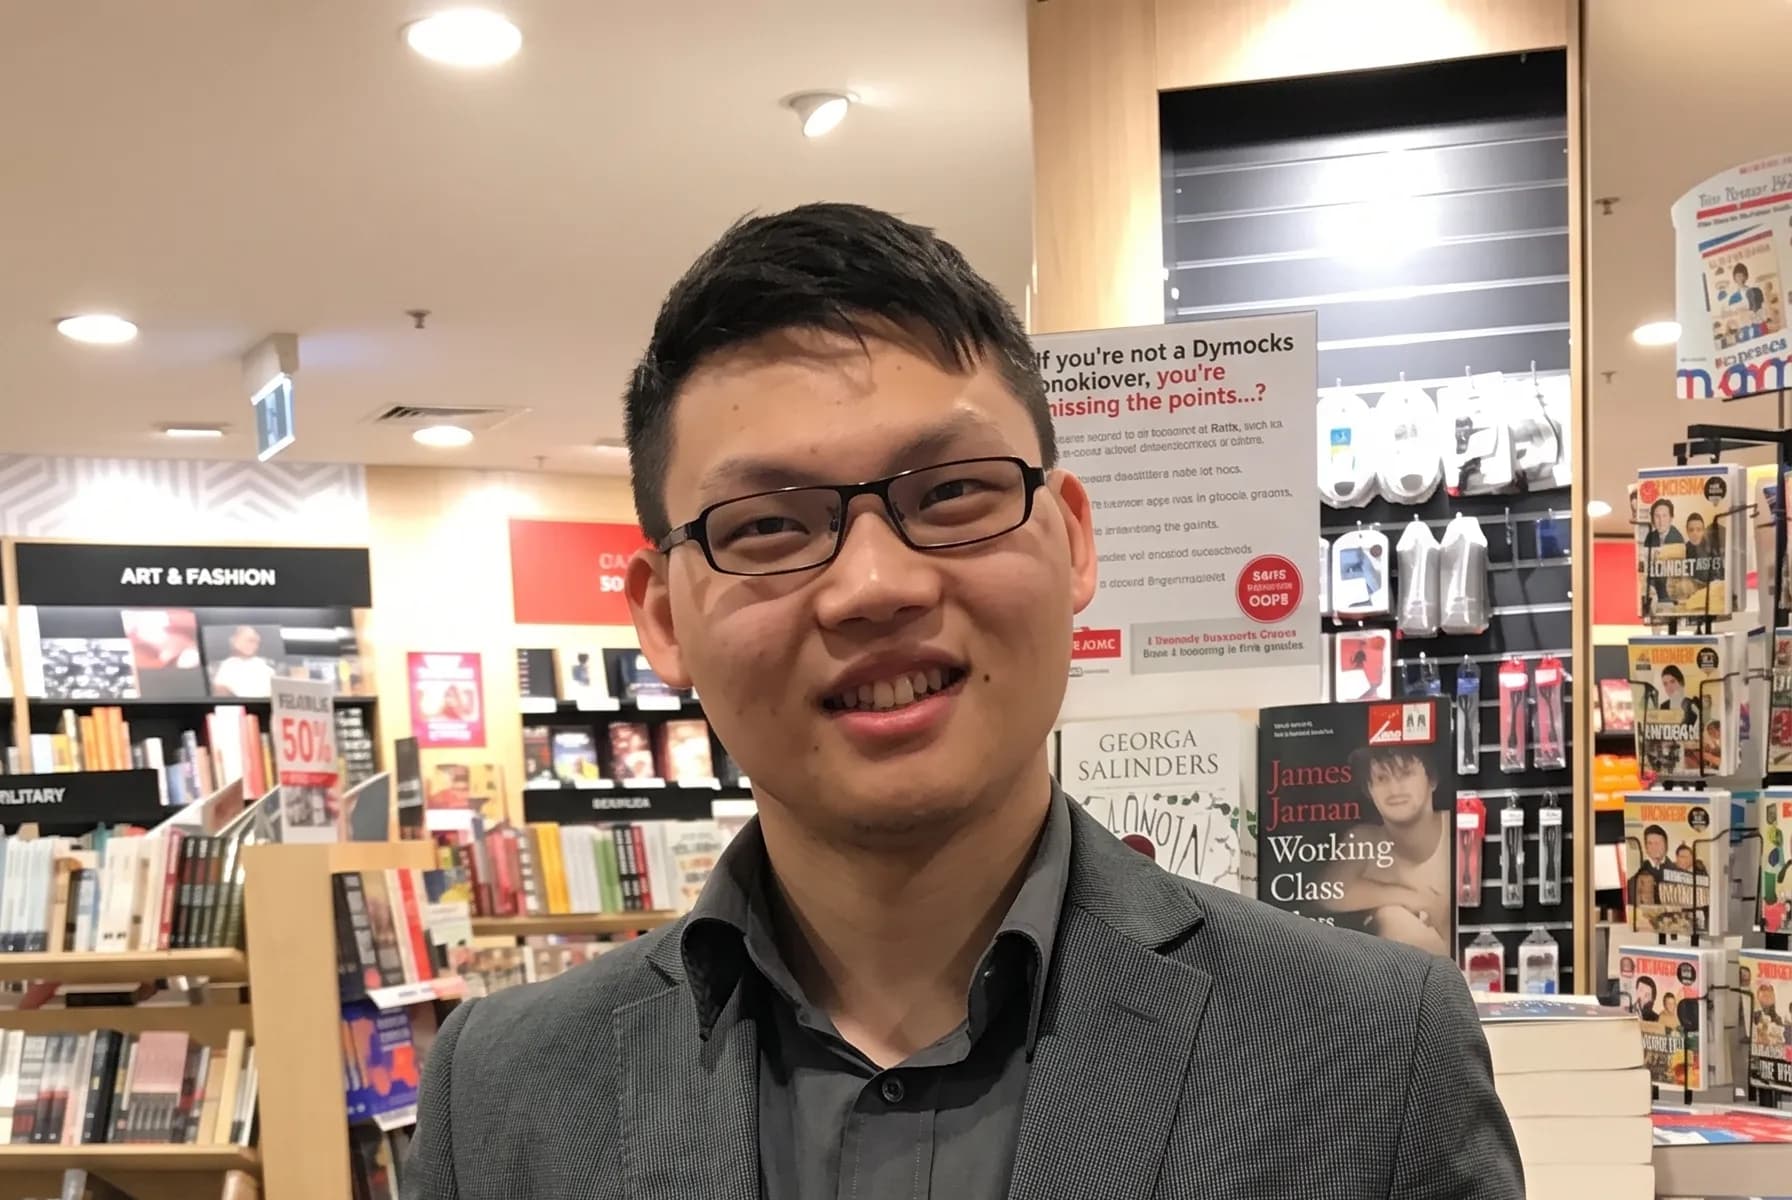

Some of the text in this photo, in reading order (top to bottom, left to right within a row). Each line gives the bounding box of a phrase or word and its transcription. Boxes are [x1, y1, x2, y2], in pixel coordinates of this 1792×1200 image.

[1056, 346, 1124, 374] you're
[1131, 344, 1167, 363] not
[1173, 344, 1186, 360] a
[1193, 333, 1294, 362] Dymocks
[1156, 364, 1226, 390] you're
[1127, 392, 1162, 412] the
[120, 567, 276, 586] ART & FASHION
[281, 718, 333, 764] 50%
[1099, 729, 1198, 753] GEORGA
[1266, 760, 1353, 794] James
[1267, 833, 1394, 868] Working
[1270, 872, 1345, 901] Class
